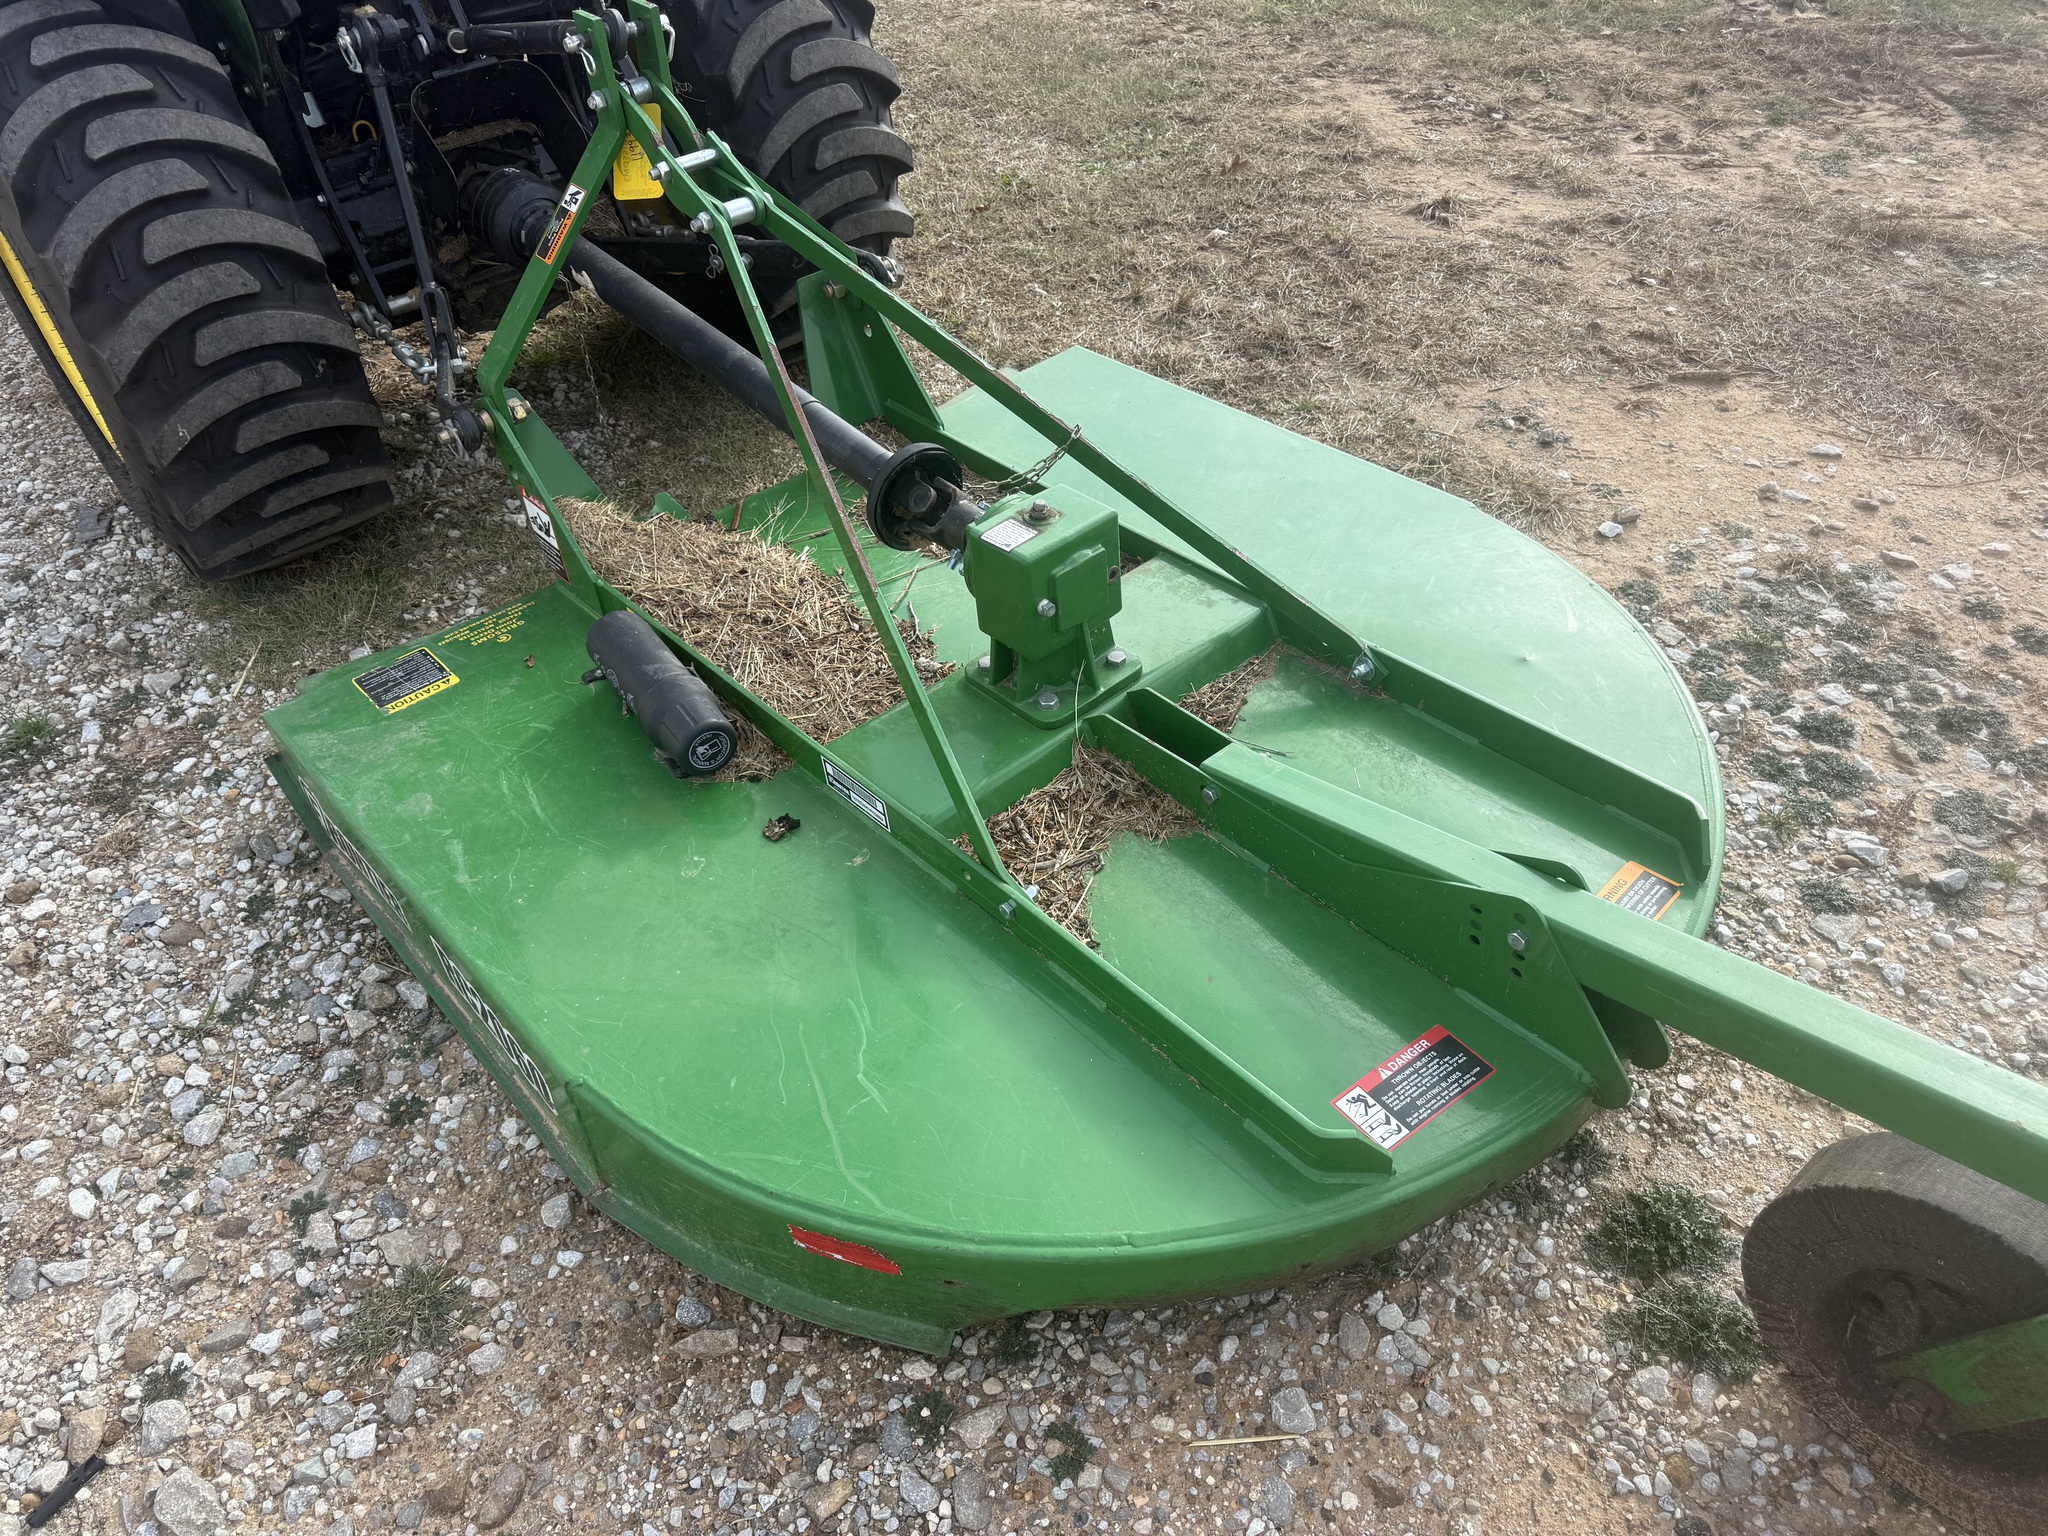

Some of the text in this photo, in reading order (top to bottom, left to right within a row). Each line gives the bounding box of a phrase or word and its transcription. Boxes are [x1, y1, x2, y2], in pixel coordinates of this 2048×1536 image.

[547, 223, 567, 260] WARNING
[470, 619, 525, 646] GRISSOMS
[388, 684, 441, 712] CAUTION
[1602, 878, 1627, 900] RNING
[430, 935, 557, 1116] RC2060
[1387, 1038, 1430, 1070] DANGER
[1390, 1050, 1437, 1084] THROWN OBJECTS
[1384, 1094, 1398, 1103] Debris
[1409, 1076, 1422, 1086] thrown
[1422, 1064, 1439, 1076] hundreds
[1388, 1099, 1400, 1107] Keep
[1432, 1063, 1449, 1076] including
[1394, 1080, 1408, 1091] operate
[1407, 1073, 1418, 1081] cutter
[1415, 1071, 1462, 1105] ROTATING BLADES
[1424, 1098, 1436, 1107] hands
[1447, 1082, 1458, 1090] under
[1393, 1097, 1412, 1111] discharge
[1411, 1086, 1426, 1097] opening
[1418, 1109, 1432, 1119] engine
[1430, 1099, 1446, 1110] running
[1448, 1086, 1461, 1096] blades
